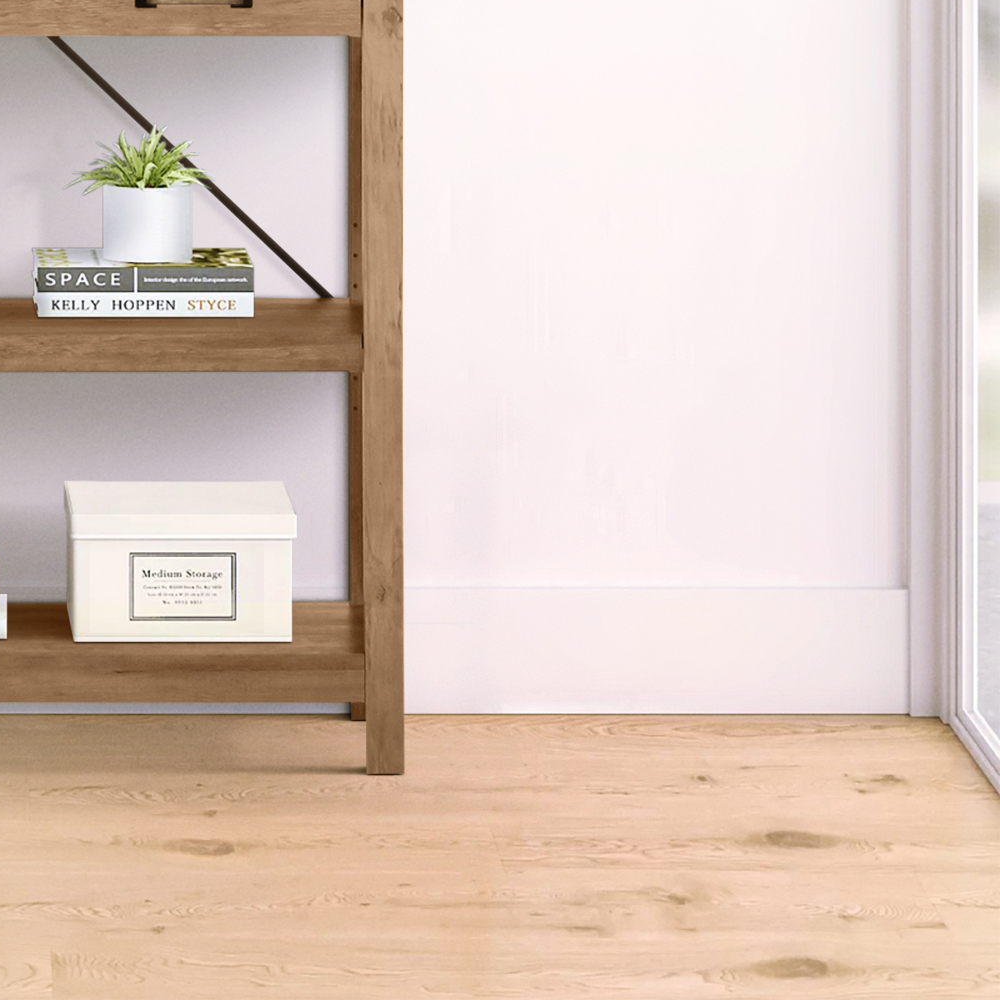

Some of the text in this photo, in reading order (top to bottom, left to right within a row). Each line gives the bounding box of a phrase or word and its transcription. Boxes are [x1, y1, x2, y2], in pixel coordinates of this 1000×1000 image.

[45, 272, 121, 286] SPACE
[51, 300, 237, 311] KELLY HOPPEN STYCE
[142, 569, 224, 580] Medium Storage
